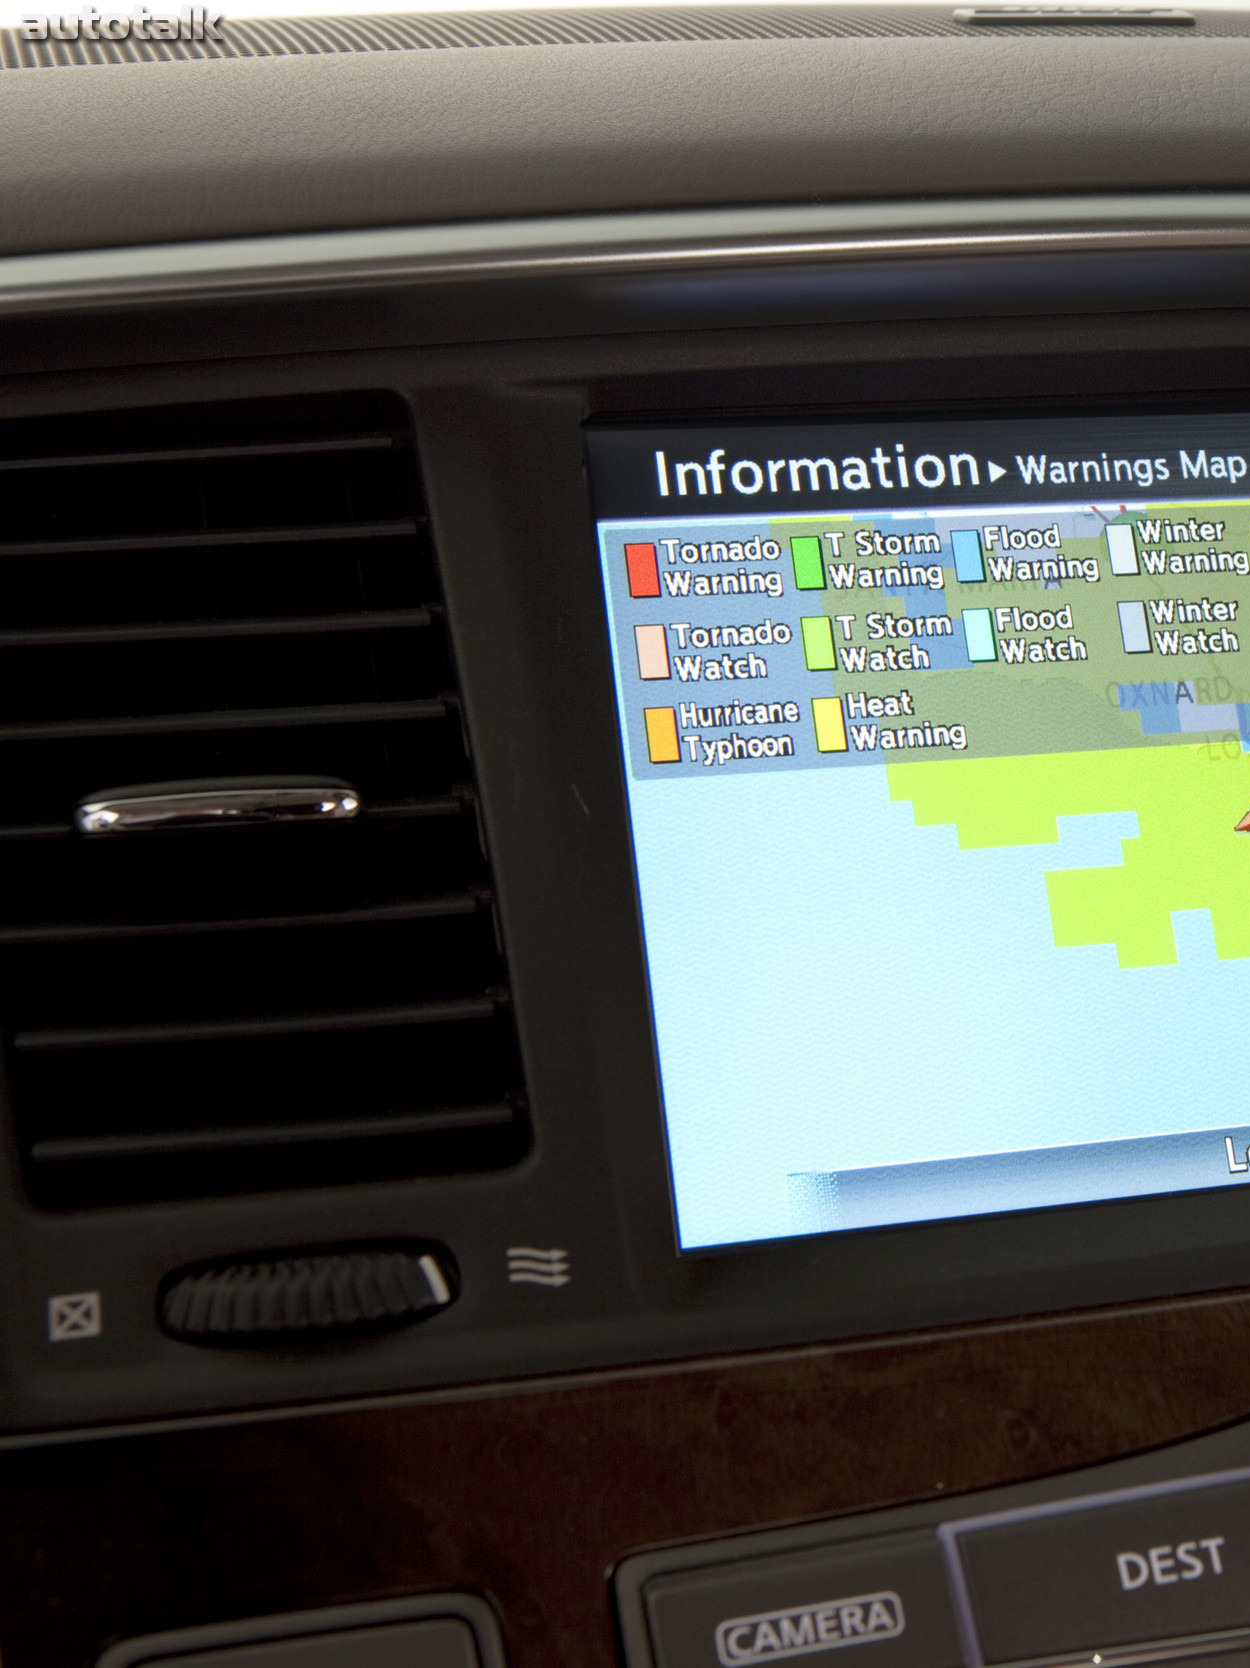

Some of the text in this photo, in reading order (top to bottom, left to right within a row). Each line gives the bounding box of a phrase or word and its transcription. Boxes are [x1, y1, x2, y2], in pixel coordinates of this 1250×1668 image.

[655, 444, 1247, 496] Information Warnings Map
[825, 530, 941, 557] T Storm
[983, 524, 1062, 550] Flood
[1136, 519, 1225, 544] Winter
[660, 536, 782, 564] Tornado
[1141, 548, 1250, 576] Warning
[663, 568, 783, 597] Warning
[828, 561, 944, 590] Warning
[988, 554, 1100, 583] Warning
[994, 605, 1074, 633] Flood
[1150, 597, 1238, 624] Winter
[669, 621, 792, 649] Tornado
[835, 613, 952, 640] T Storm
[999, 636, 1088, 664] Watch
[1155, 627, 1240, 655] Watch
[673, 653, 767, 682] Watch
[839, 644, 930, 672] Watch
[679, 701, 799, 729] Hurricane
[846, 690, 914, 718] Heat
[681, 733, 795, 766] Typhoon
[850, 721, 967, 751] Warning
[1117, 1537, 1225, 1591] DEST
[726, 1600, 896, 1660] CAMERA
